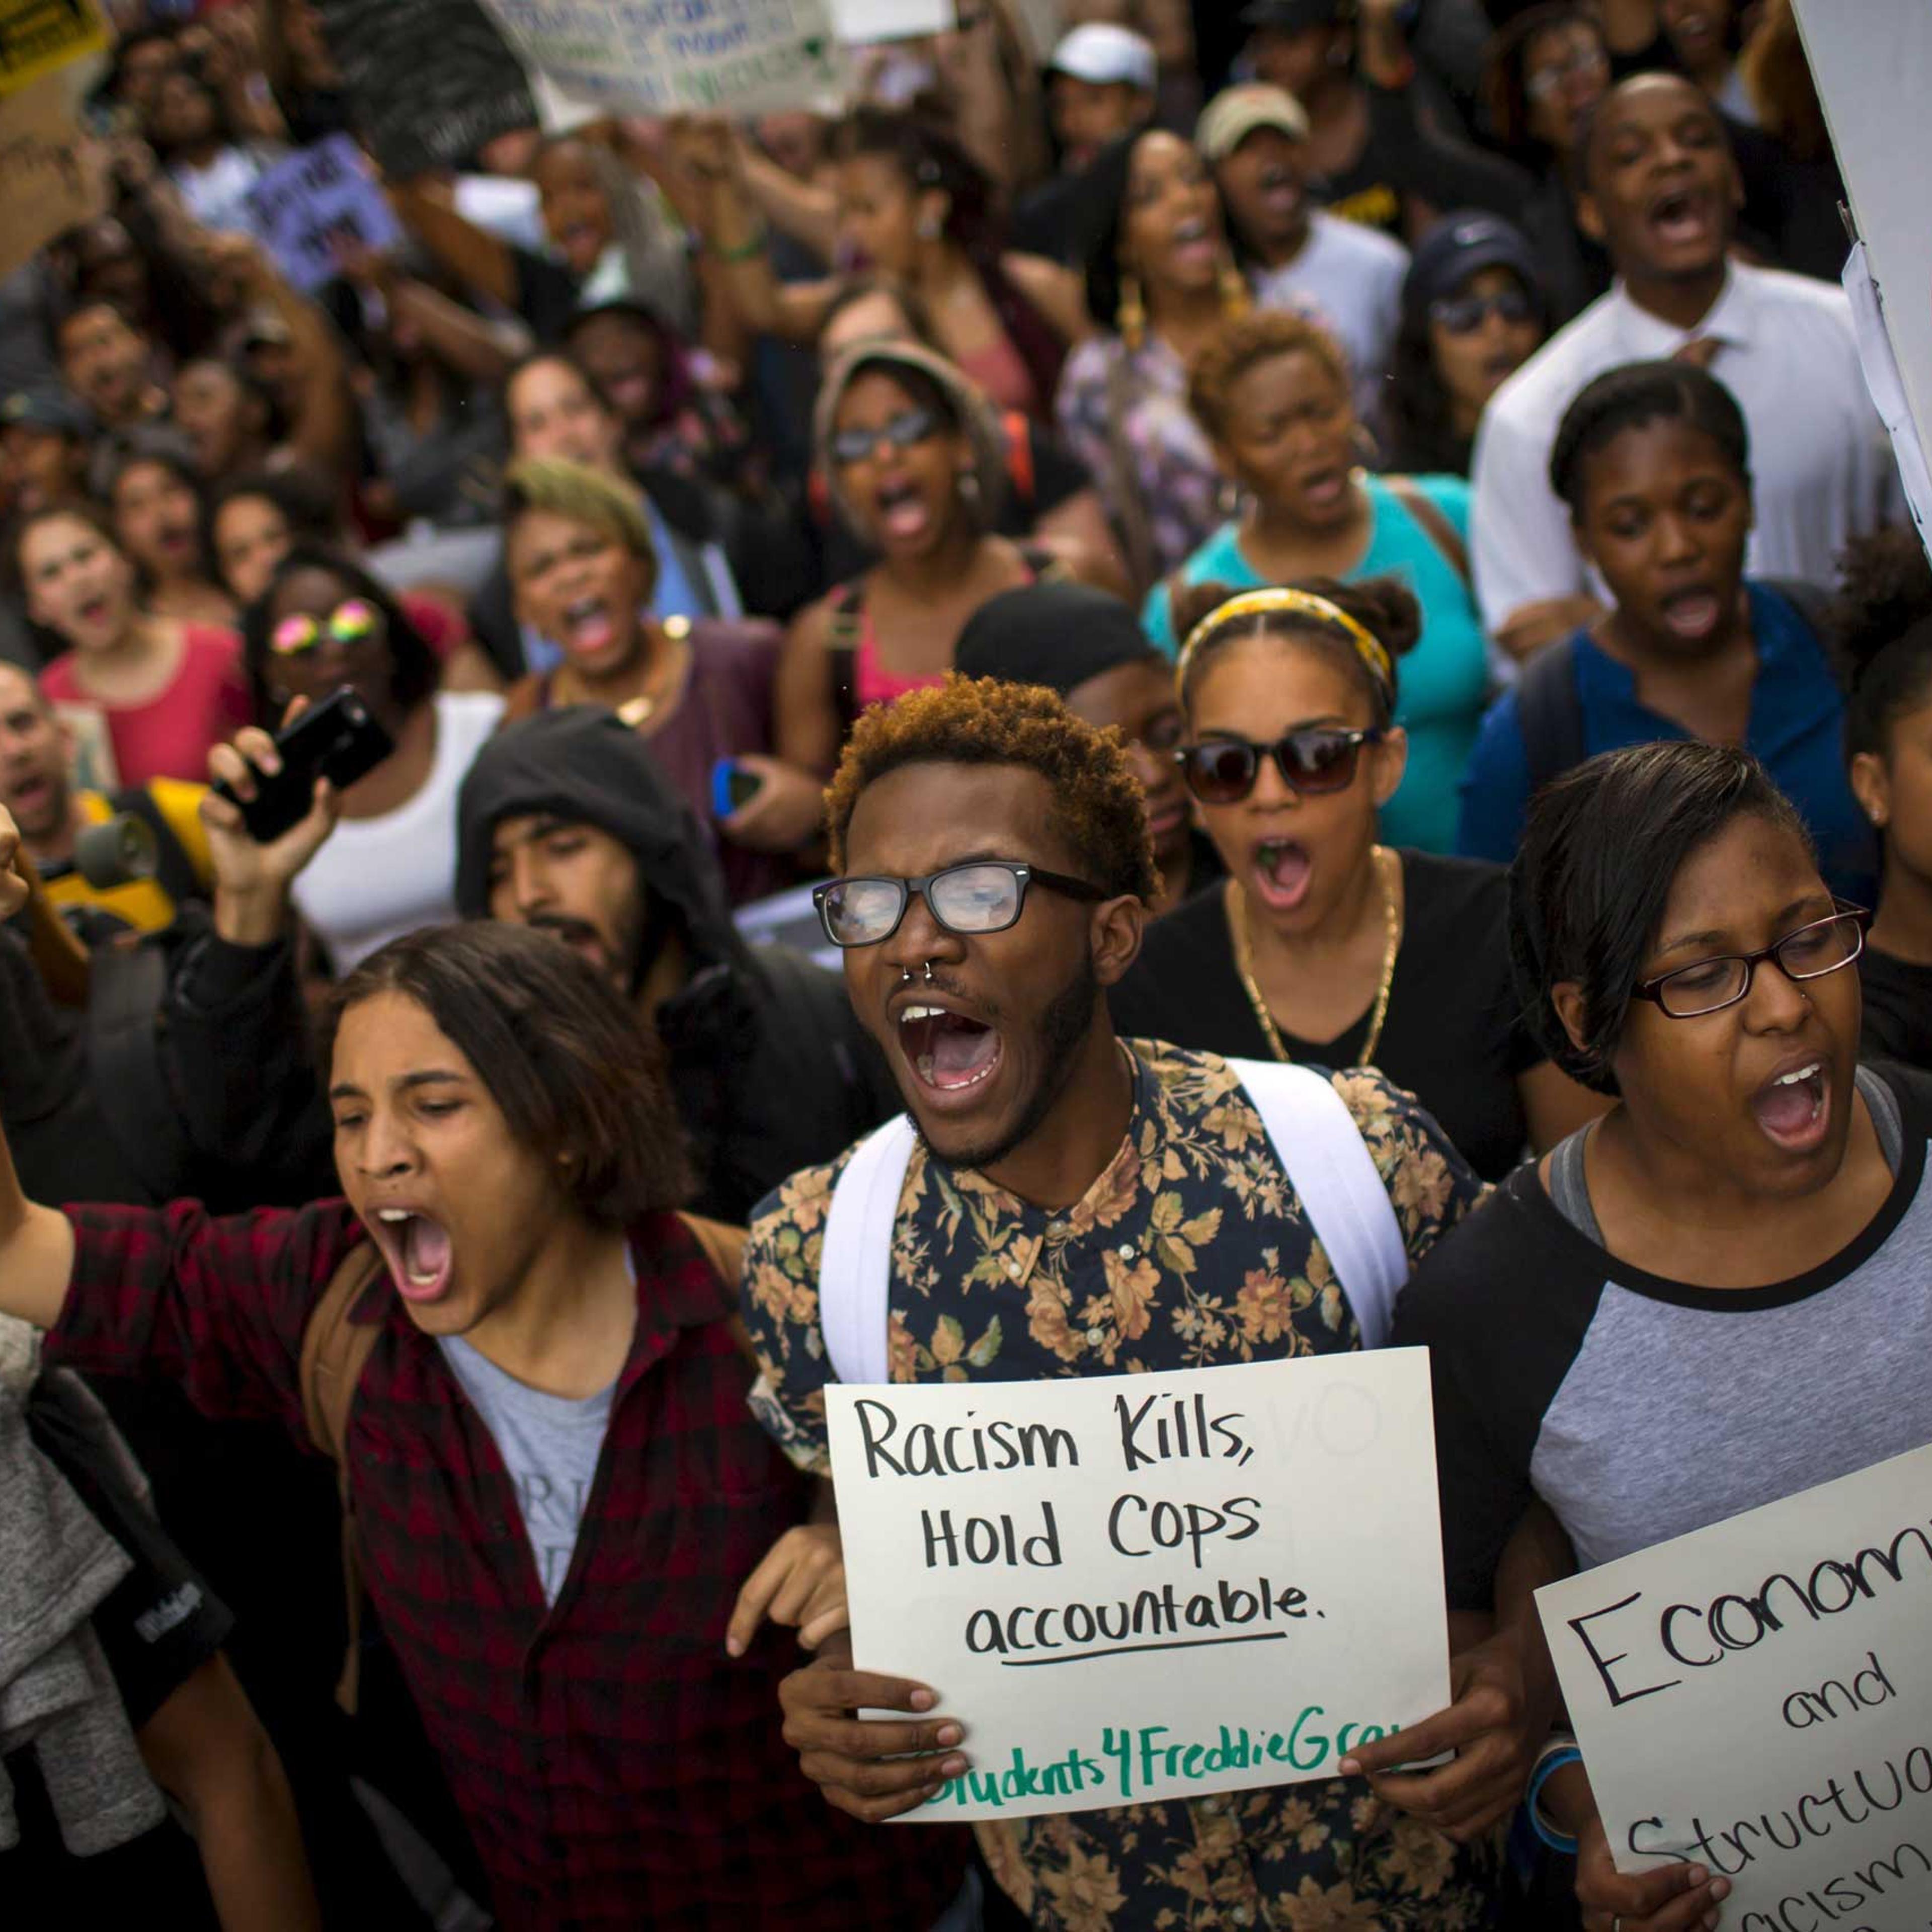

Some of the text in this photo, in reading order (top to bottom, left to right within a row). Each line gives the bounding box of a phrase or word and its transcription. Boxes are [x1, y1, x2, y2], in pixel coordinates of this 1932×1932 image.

[854, 1399, 1079, 1478] Racism
[1113, 1393, 1254, 1471] Kills,
[921, 1494, 1261, 1568] Hold Cops
[965, 1577, 1326, 1654] accountable.
[1566, 1518, 1932, 1707] Econom
[1782, 1651, 1897, 1729] and
[923, 1706, 1402, 1809] tudents4FreddieGra
